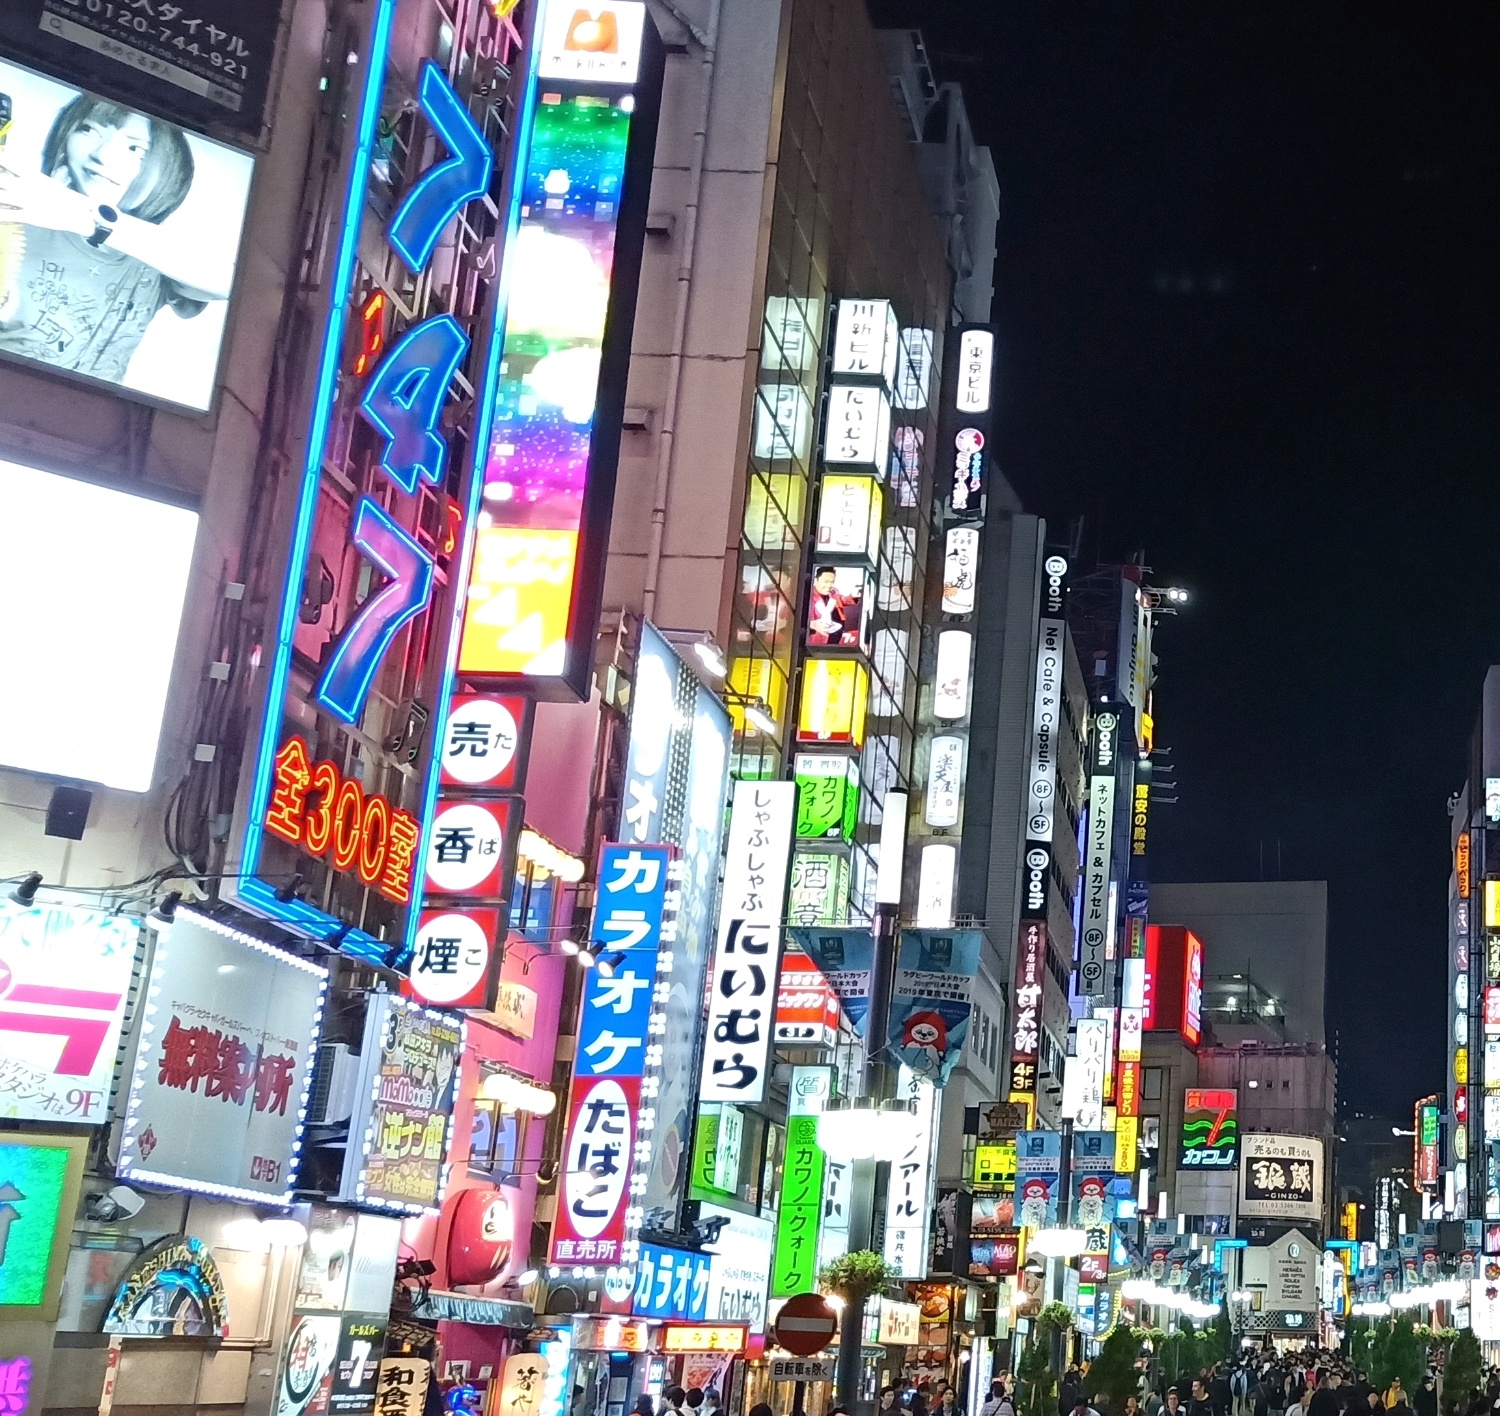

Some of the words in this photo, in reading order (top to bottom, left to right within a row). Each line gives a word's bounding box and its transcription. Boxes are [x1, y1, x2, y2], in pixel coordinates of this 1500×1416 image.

[848, 303, 874, 371] 川新ビル
[965, 346, 985, 404] 東京ビル
[841, 390, 864, 459] にいむら
[1045, 556, 1067, 612] Booth
[1046, 627, 1058, 652] Net
[1043, 657, 1055, 691] Cafe
[1042, 697, 1054, 706] &
[448, 721, 489, 758] 売
[1037, 715, 1053, 772] Capsule
[1096, 713, 1116, 766] Booth
[266, 734, 422, 904] 全300室
[1095, 784, 1108, 851] ネットカフェ
[1133, 784, 1149, 855] 驚安の殿堂
[434, 827, 474, 864] 香
[740, 788, 772, 912] しゃぶしゃぶ
[1027, 849, 1049, 909] Booth
[1089, 872, 1103, 919] カプセル
[418, 938, 463, 974] 煙
[584, 850, 661, 1074] カラオケ
[711, 919, 770, 1089] にいむら
[1014, 984, 1041, 1053] 甘太郎
[158, 1014, 296, 1117] 無料案内所
[1013, 1064, 1034, 1076] 4F
[1013, 1077, 1033, 1089] 3F
[65, 1088, 104, 1118] 9F
[382, 1111, 446, 1161] 逆ナン館
[570, 1098, 627, 1218] たばこ
[1182, 1149, 1234, 1165] カワノ
[1254, 1145, 1312, 1158] 売るのも買うのも
[1252, 1160, 1311, 1194] 銀蔵
[784, 1149, 813, 1290] カワノ・クォーク
[556, 1240, 617, 1260] 直売所
[633, 1250, 710, 1314] カラオケ
[719, 1286, 762, 1321] にいむら
[349, 1325, 379, 1336] ガールズバー
[773, 1362, 828, 1377] 自転車を除く
